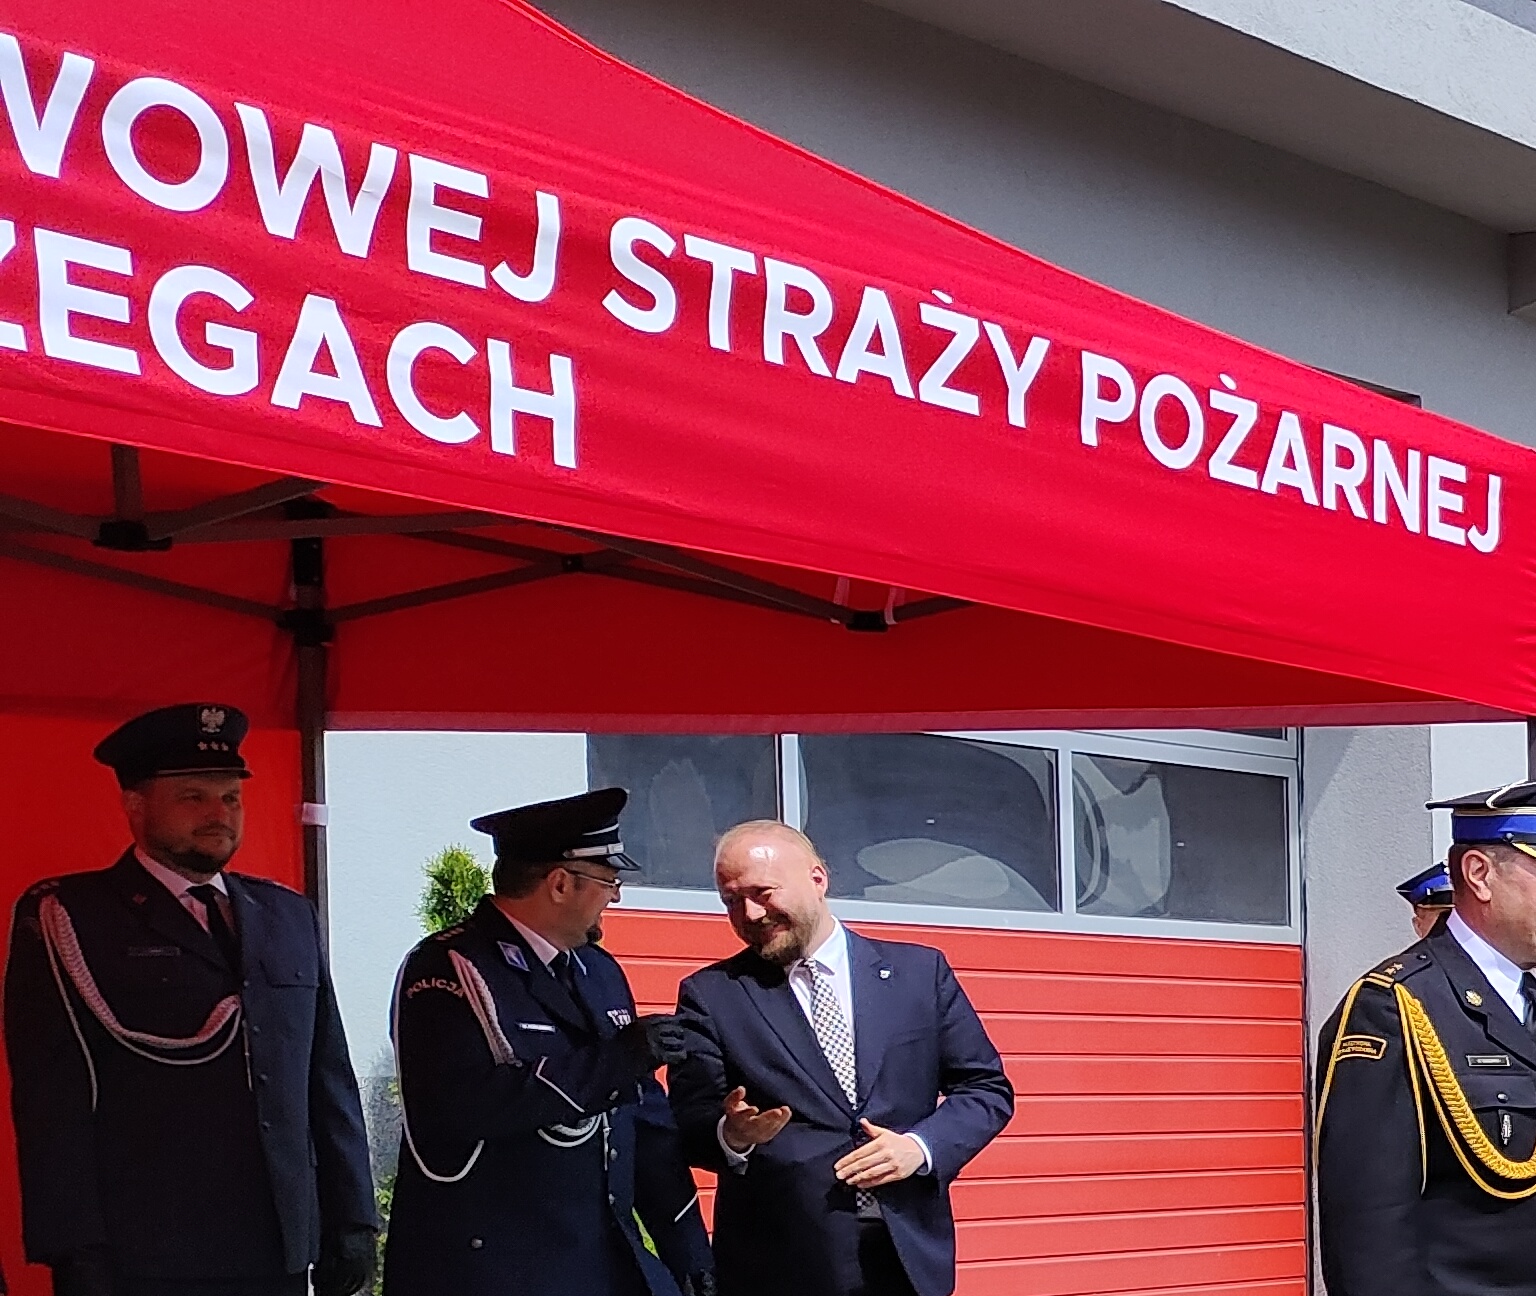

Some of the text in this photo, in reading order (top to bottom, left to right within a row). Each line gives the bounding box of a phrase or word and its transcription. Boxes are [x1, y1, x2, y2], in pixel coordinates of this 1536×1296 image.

[0, 219, 577, 469] EGACH
[601, 217, 1051, 429] STRAŻY
[1080, 350, 1503, 554] POŻARNEJ
[406, 977, 466, 999] POLICJA
